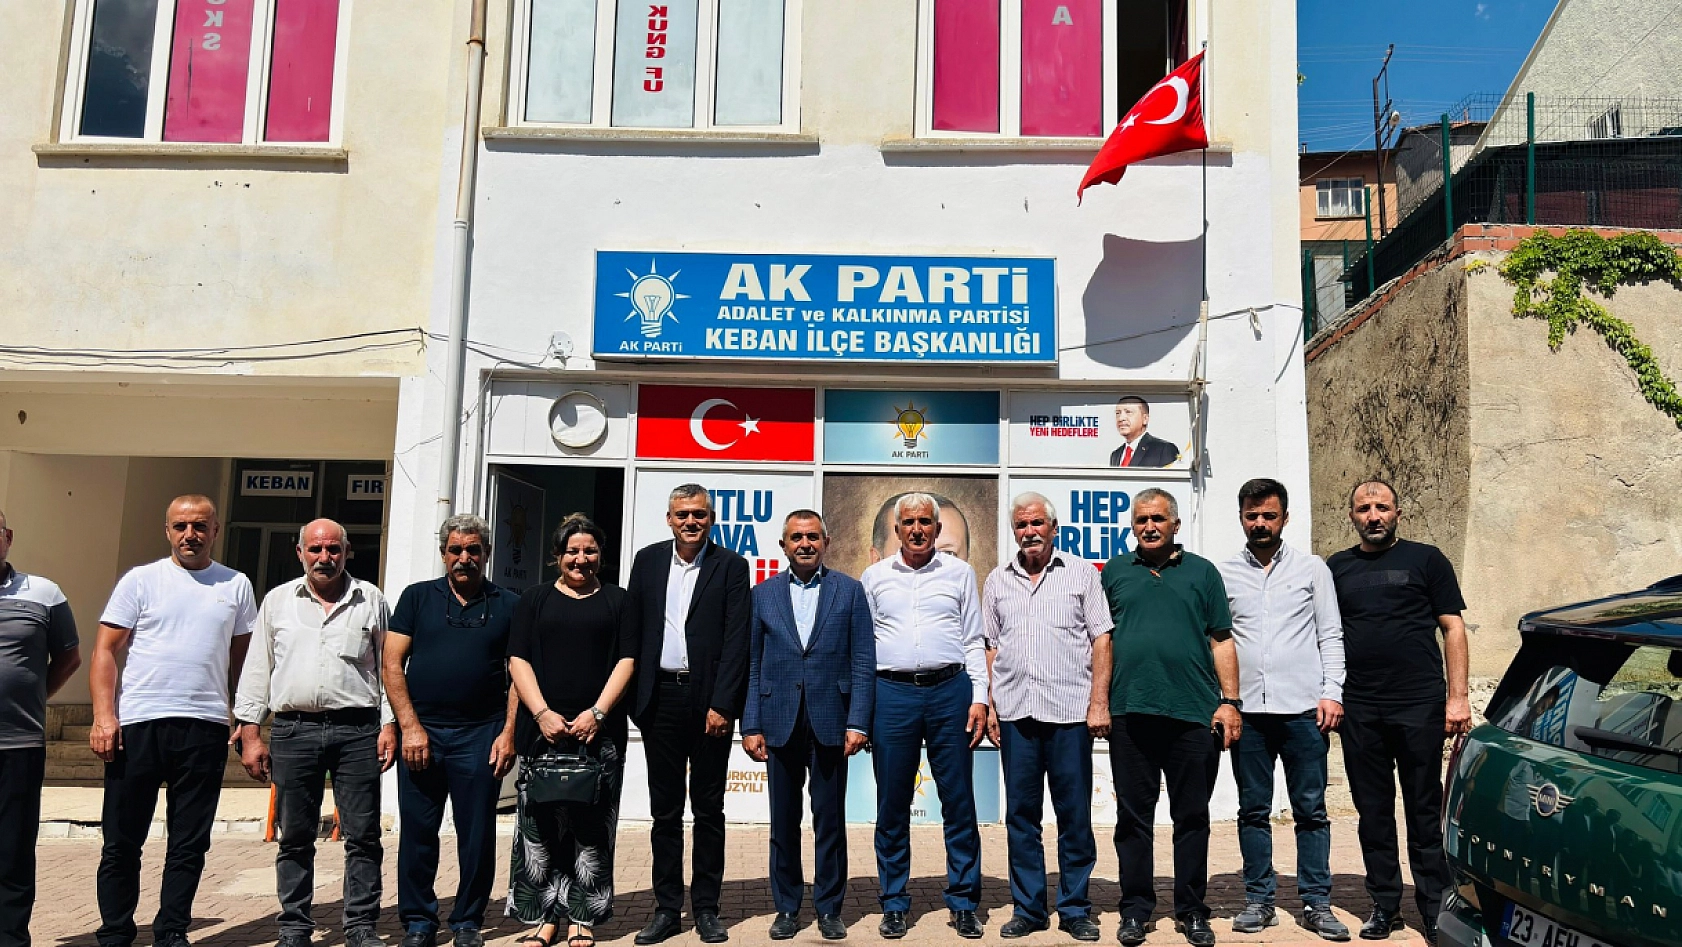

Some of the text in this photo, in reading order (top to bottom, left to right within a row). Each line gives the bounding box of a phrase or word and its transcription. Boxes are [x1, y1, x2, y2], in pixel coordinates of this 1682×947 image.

[1051, 5, 1074, 26] A
[719, 263, 813, 302] AK
[717, 305, 796, 321] ADALET
[801, 310, 826, 322] ve
[832, 308, 943, 323] KALKINMA
[619, 340, 640, 351] AK
[705, 323, 1041, 358] KEBAN İLÇE BAŞKANLIĞI
[1029, 415, 1050, 427] HEP
[1051, 428, 1099, 438] HEDEFLERE
[891, 450, 904, 458] AK
[246, 475, 310, 491] KEBAN
[352, 479, 384, 494] FIR
[1070, 490, 1131, 524] HEP
[1457, 828, 1668, 919] COUNTRYMAN
[1510, 909, 1534, 943] 23
